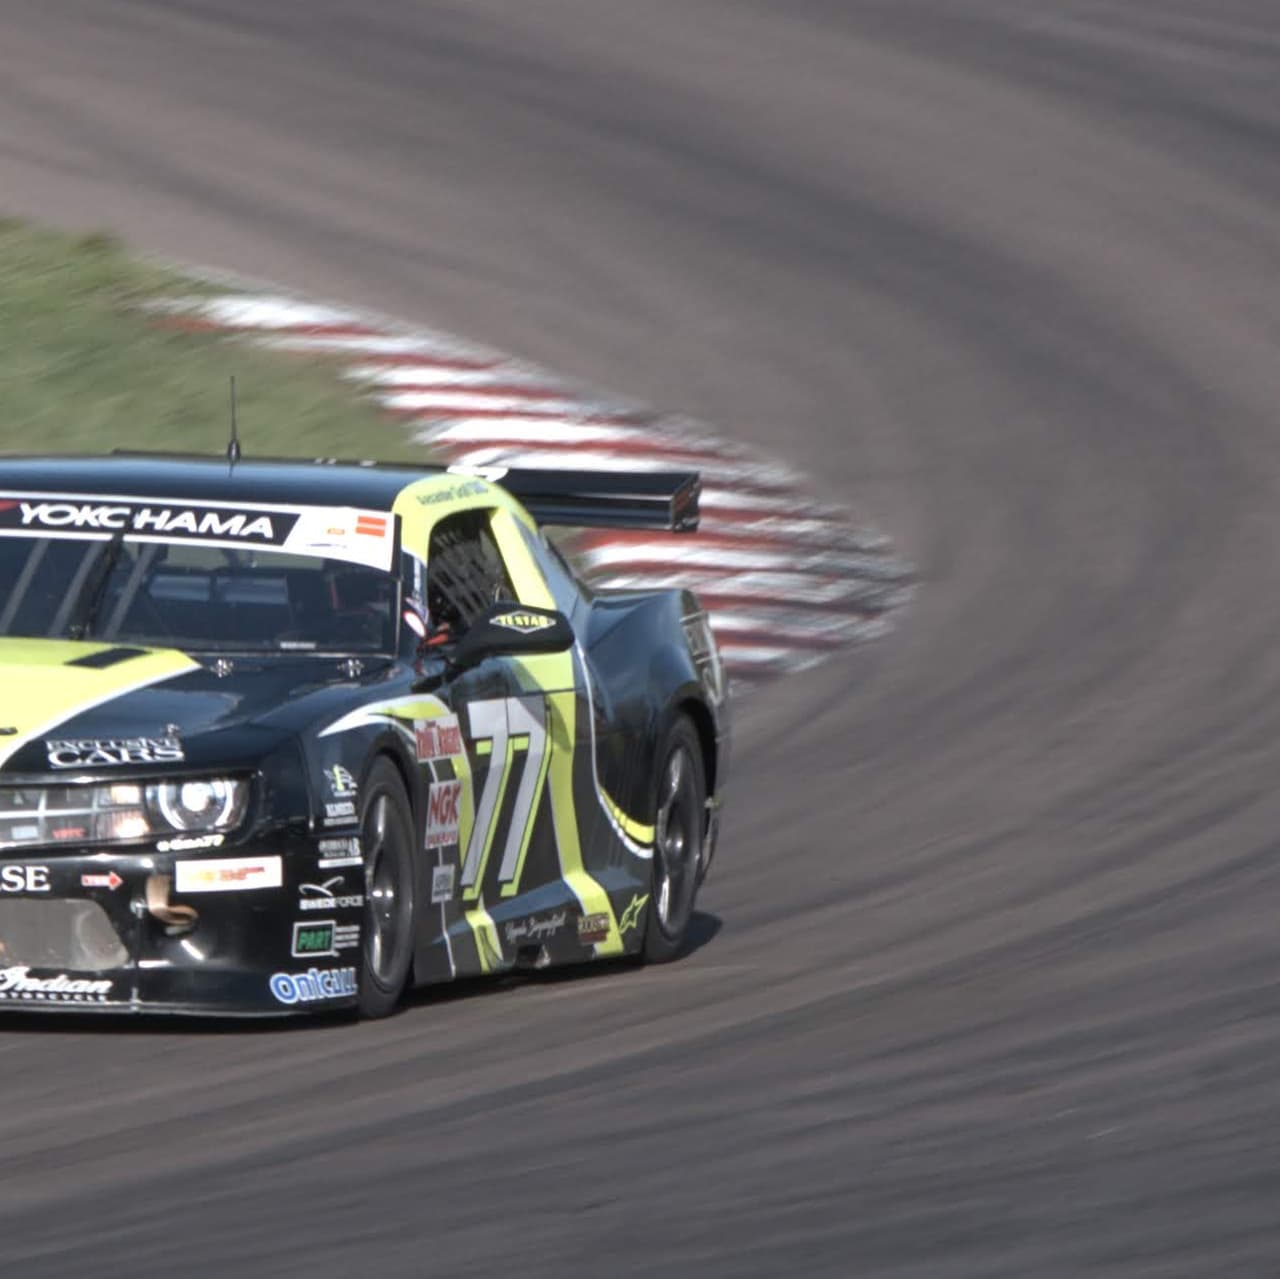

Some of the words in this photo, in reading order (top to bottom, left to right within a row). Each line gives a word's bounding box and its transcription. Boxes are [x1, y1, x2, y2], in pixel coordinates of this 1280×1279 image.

[19, 501, 275, 539] YOKOHAMA
[47, 748, 185, 770] CARS
[428, 783, 462, 828] NGK
[460, 695, 554, 900] 77
